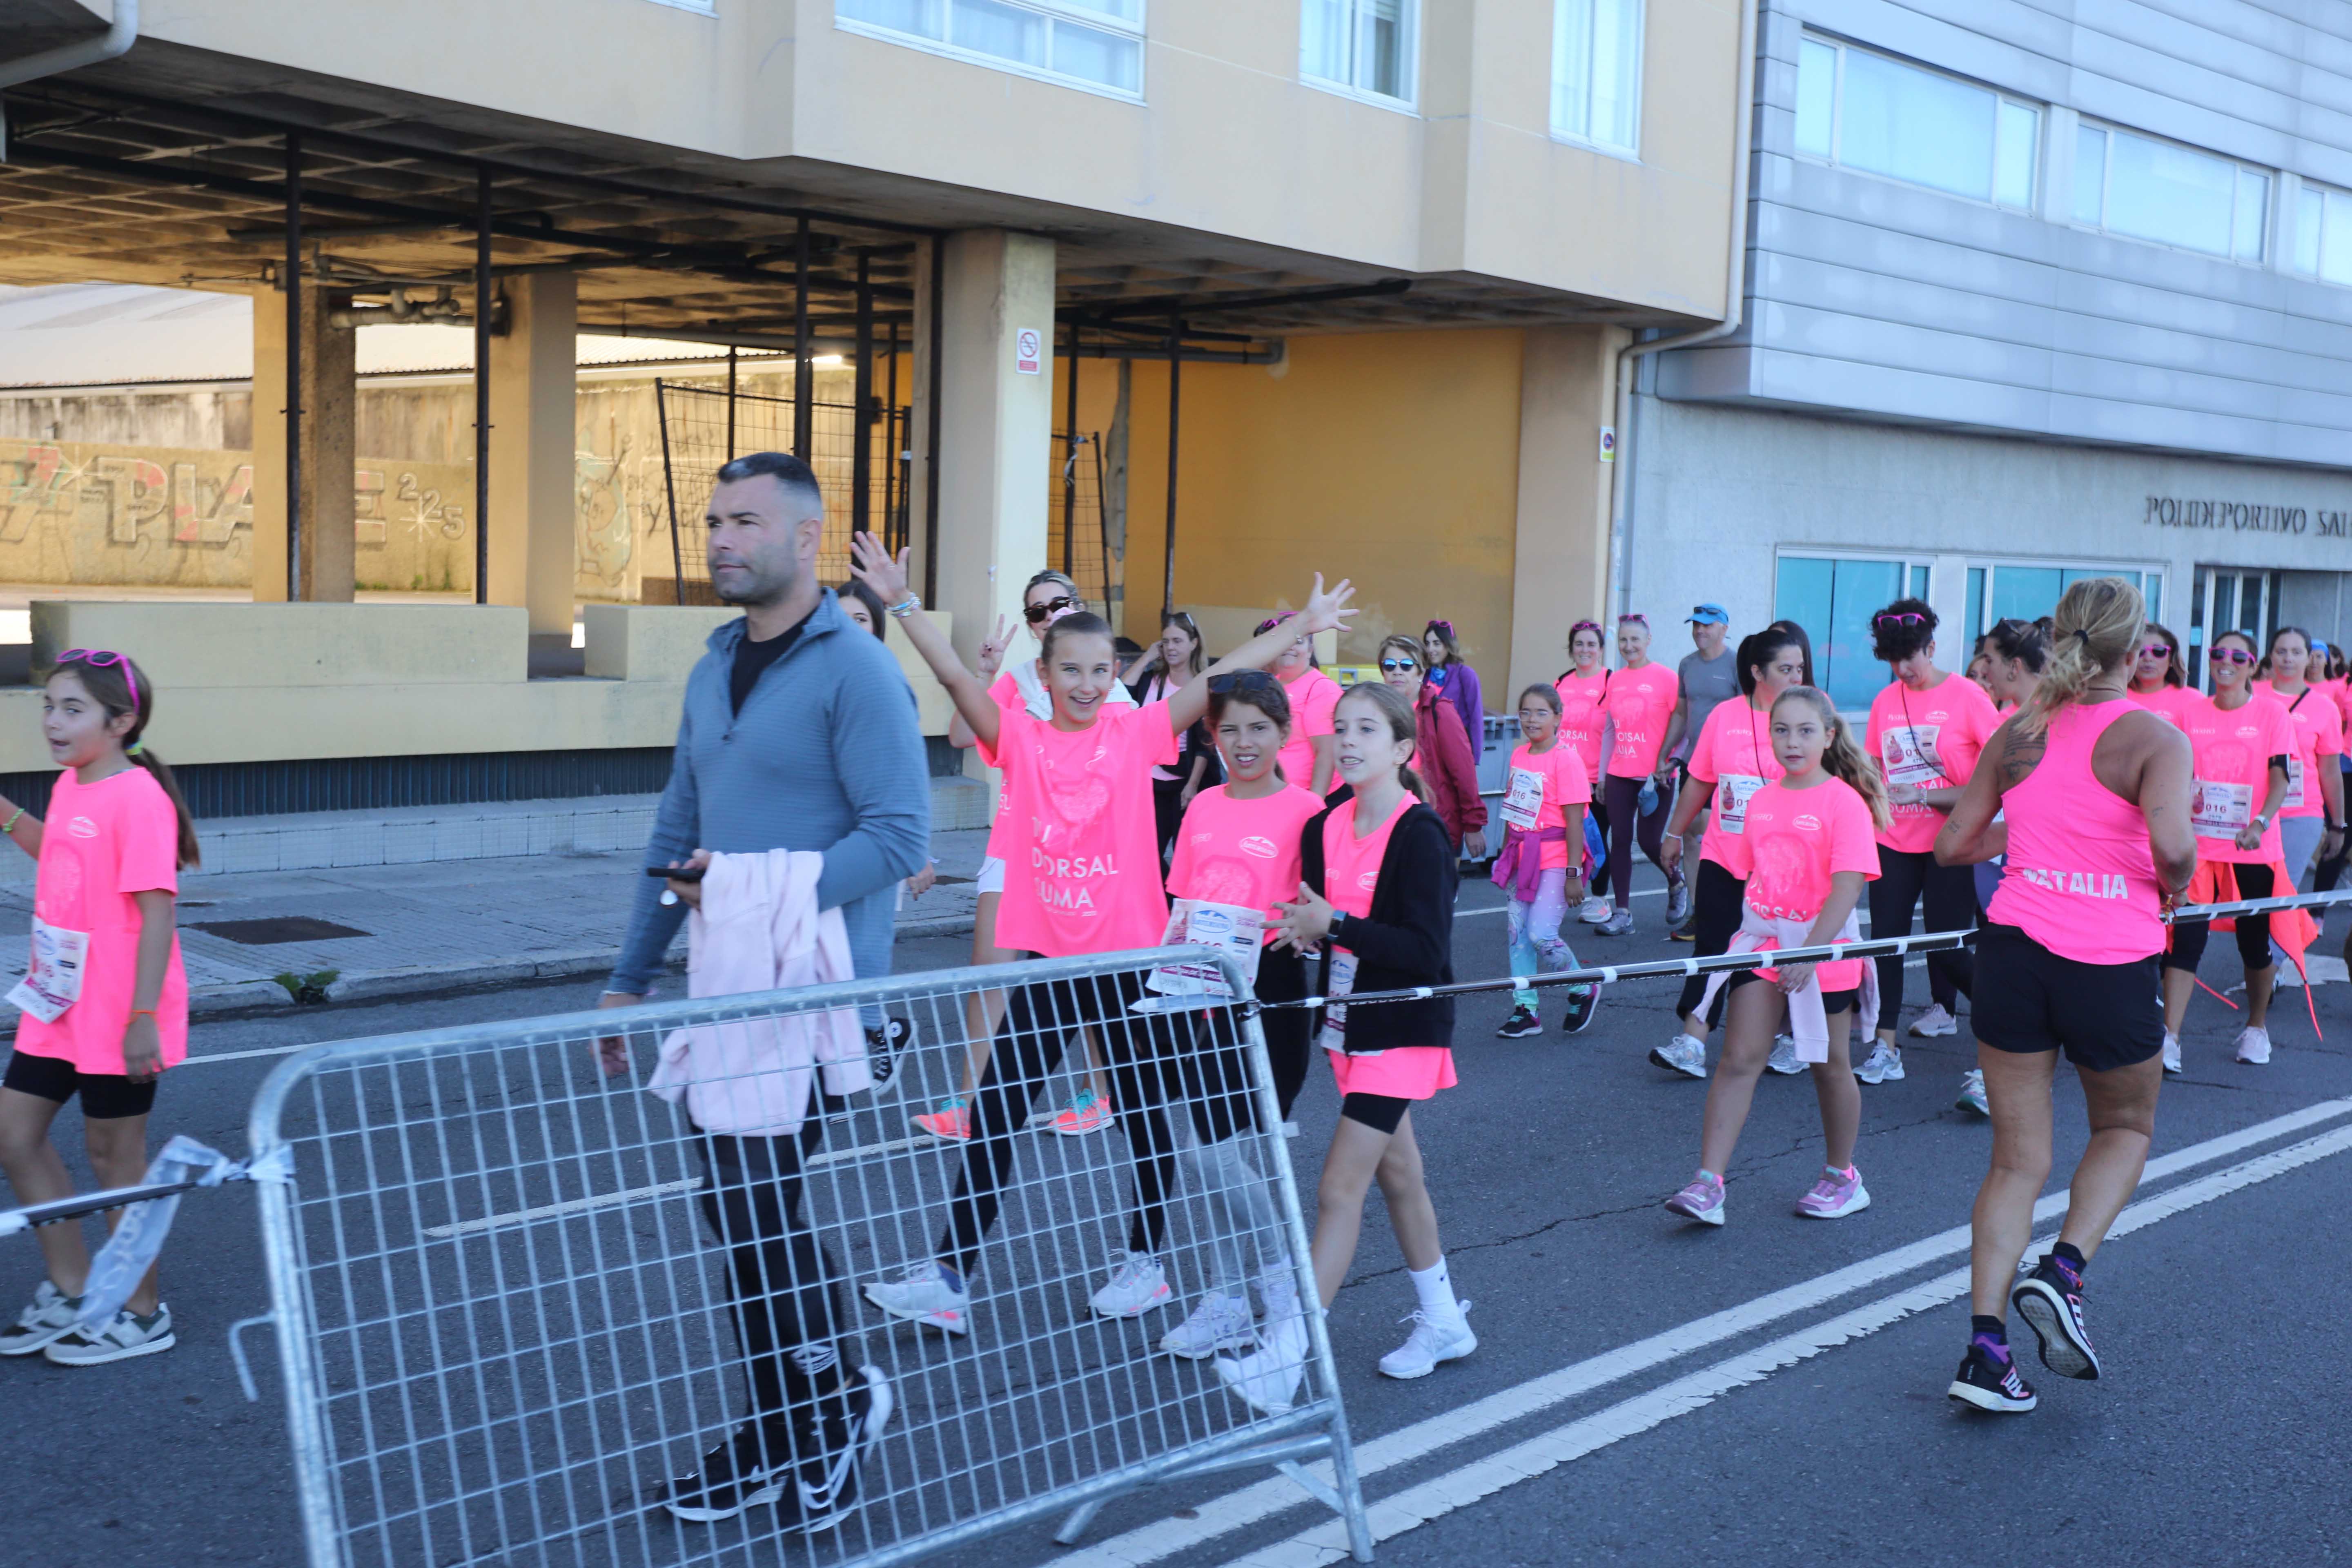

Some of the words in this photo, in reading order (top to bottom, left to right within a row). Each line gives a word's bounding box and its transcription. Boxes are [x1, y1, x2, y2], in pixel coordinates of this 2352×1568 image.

[1556, 729, 1588, 742] ORSAL
[1512, 789, 1526, 800] 016
[2206, 804, 2227, 813] 016
[1032, 846, 1120, 878] DORSAL
[2022, 868, 2129, 900] NATALIA
